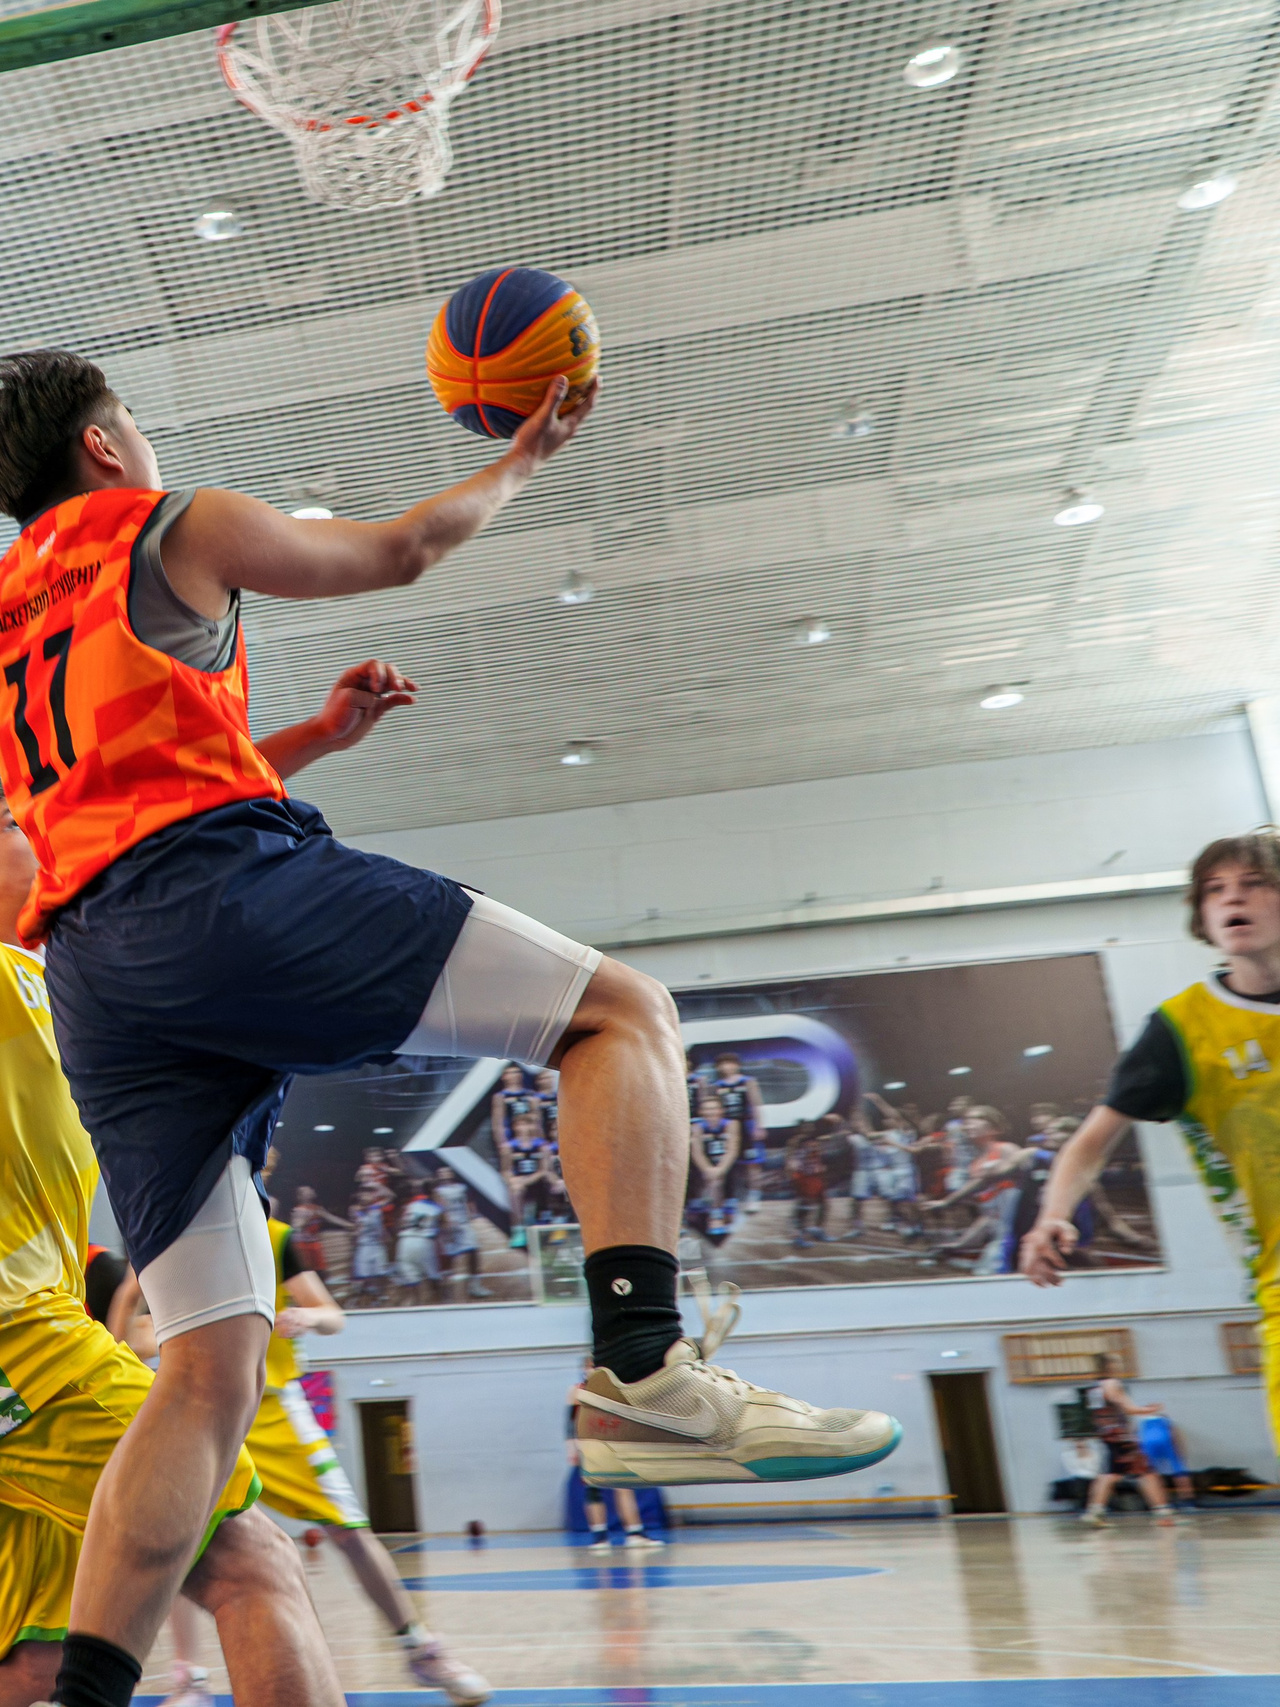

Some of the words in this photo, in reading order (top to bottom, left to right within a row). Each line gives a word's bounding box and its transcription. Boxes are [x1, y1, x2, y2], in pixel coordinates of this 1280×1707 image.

[50, 558, 107, 607] СТУДЕНТА
[4, 627, 78, 797] 17
[1221, 1038, 1273, 1081] 14
